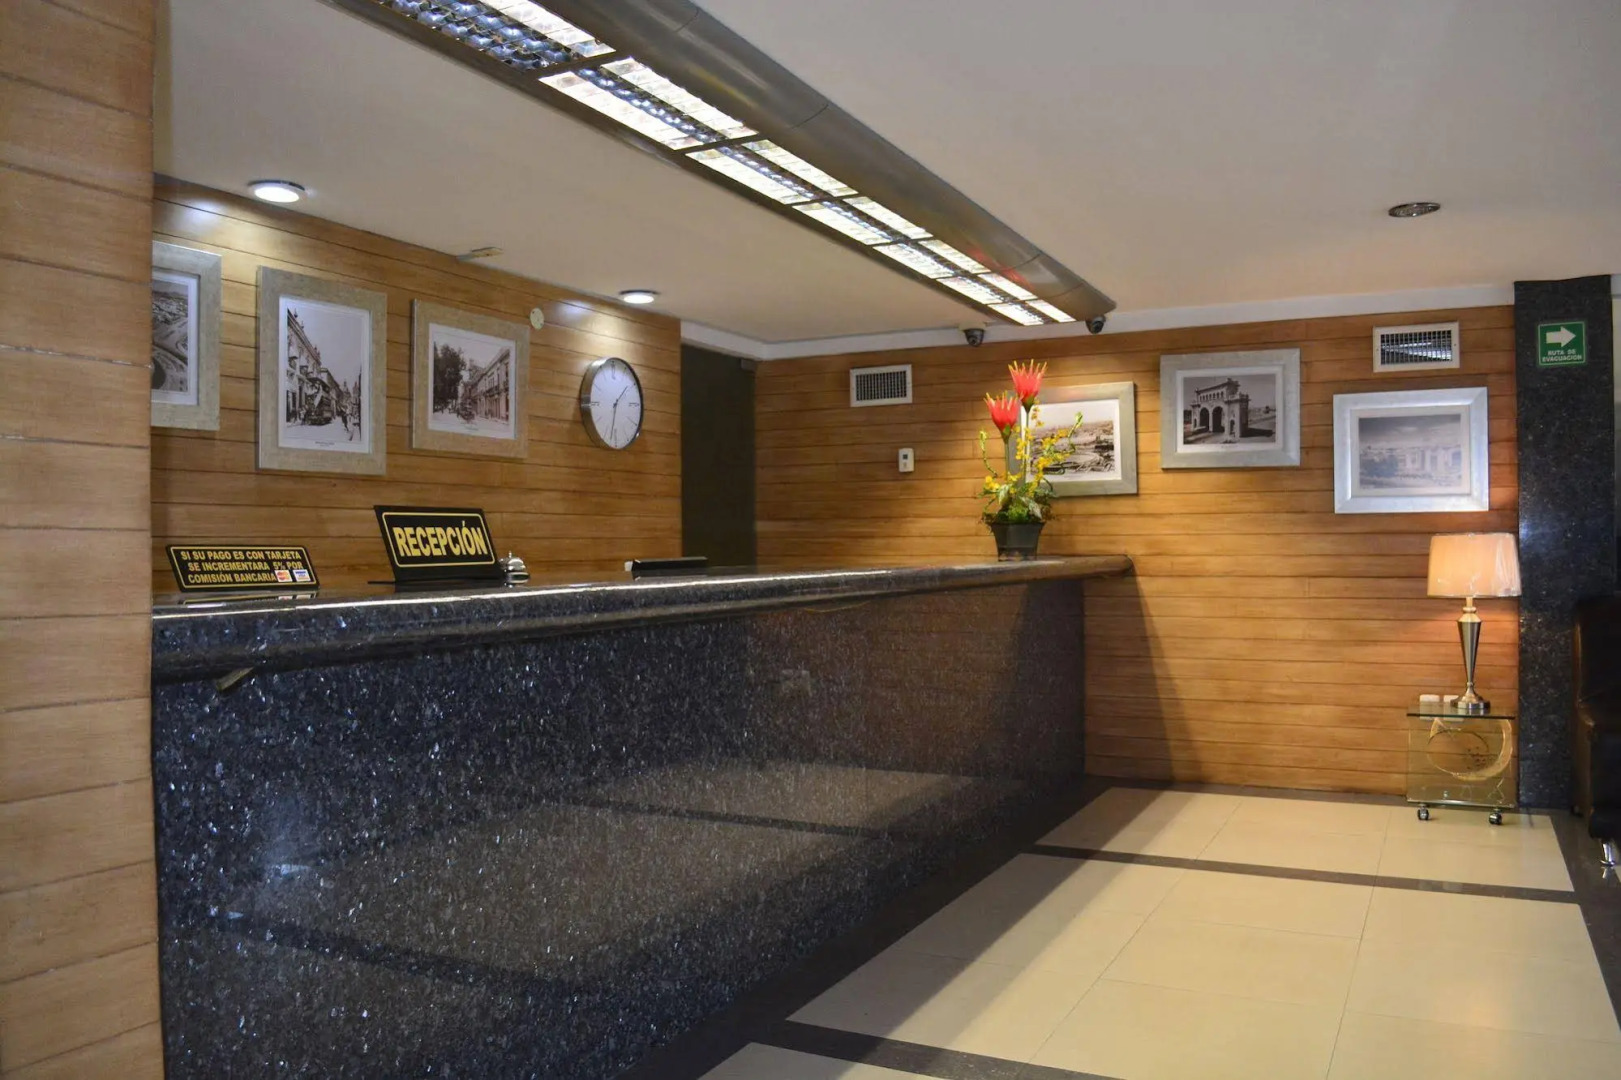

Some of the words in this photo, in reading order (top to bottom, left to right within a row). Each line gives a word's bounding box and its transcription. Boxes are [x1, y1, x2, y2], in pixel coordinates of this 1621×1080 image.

[392, 520, 489, 557] RECEPCIÓN
[180, 551, 190, 560] SI
[193, 551, 206, 560] SU
[207, 551, 232, 560] PAGO
[233, 551, 245, 559] ES
[246, 551, 265, 560] CON
[267, 551, 302, 560] TARJETA
[188, 562, 201, 571] SE
[202, 561, 270, 571] INCREMENTARA
[273, 561, 286, 570] 5%
[287, 561, 304, 570] POR
[188, 571, 233, 584] COMISIÓN
[234, 572, 277, 583] BANCARIA
